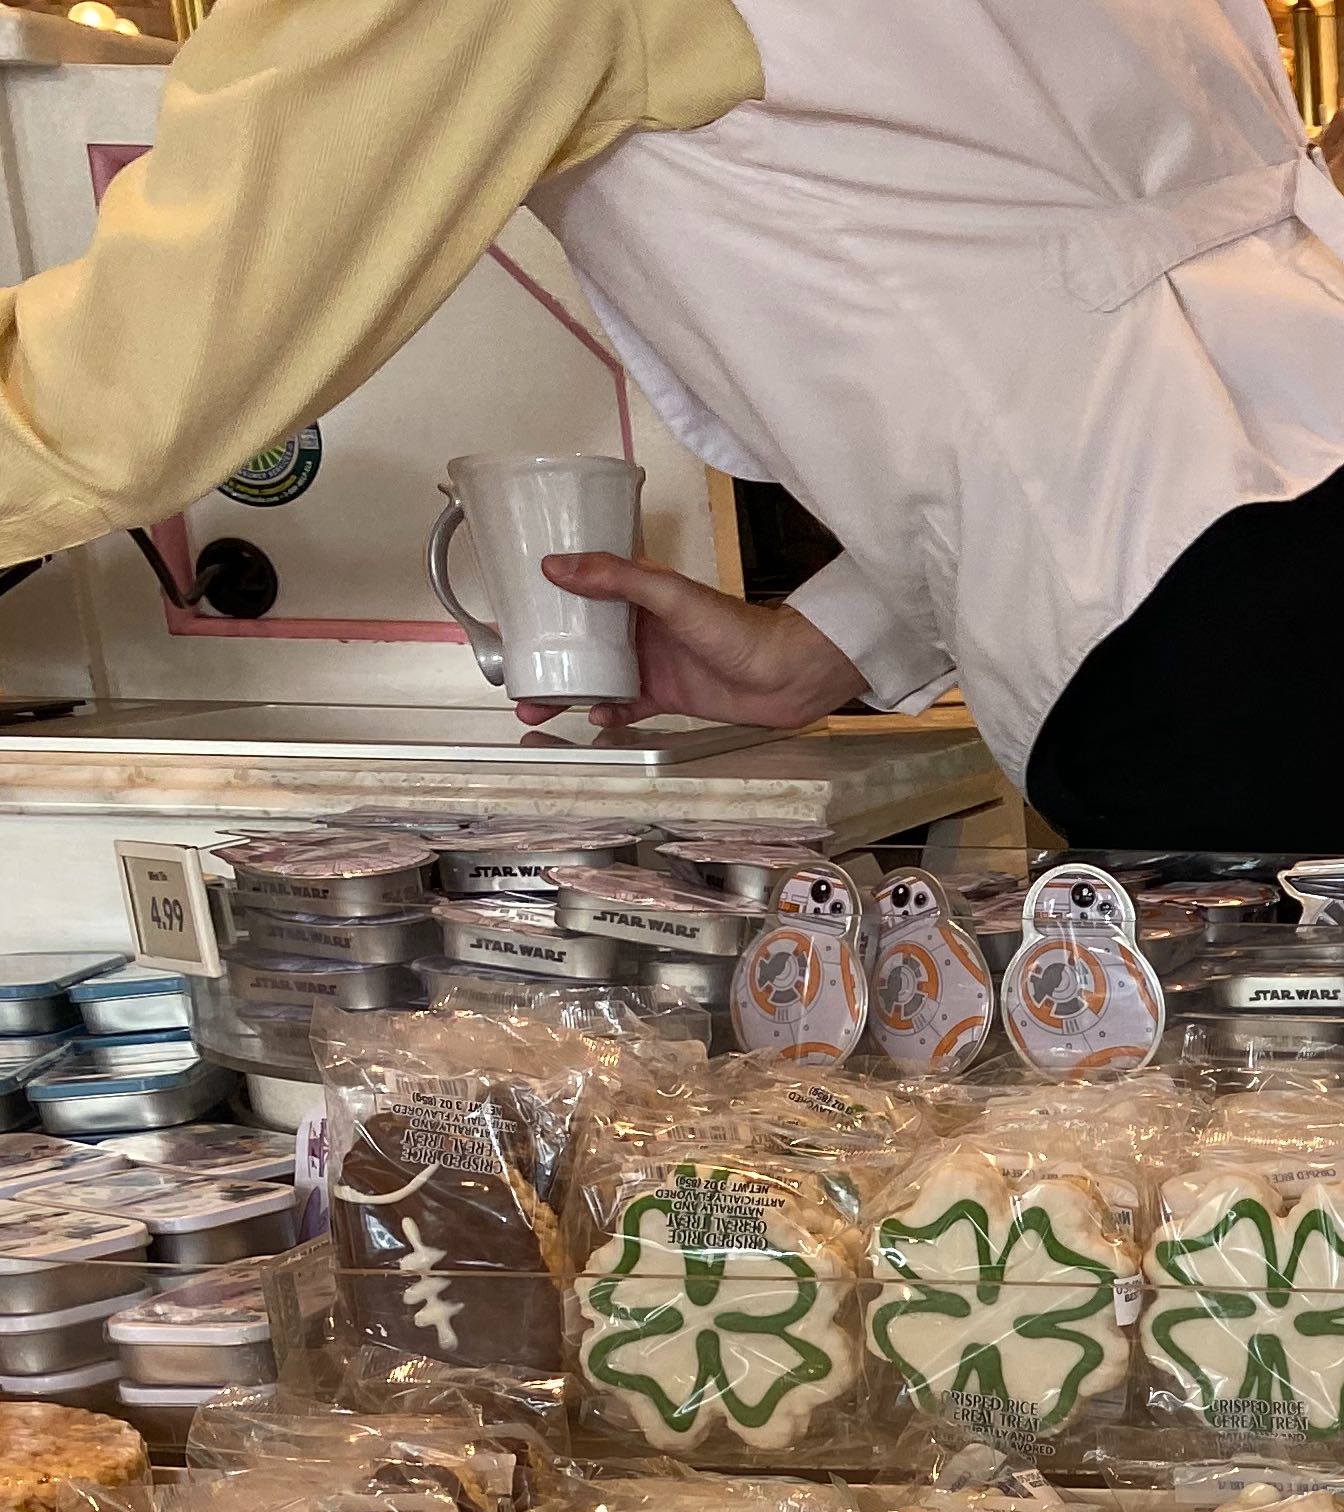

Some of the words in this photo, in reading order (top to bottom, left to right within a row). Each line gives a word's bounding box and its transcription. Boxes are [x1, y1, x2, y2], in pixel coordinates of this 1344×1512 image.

[470, 866, 517, 878] STAR
[151, 896, 183, 932] 4.99
[593, 911, 646, 928] STAR
[646, 919, 699, 938] WARS
[470, 938, 518, 954] STAR
[518, 944, 566, 962] WARS
[1249, 990, 1295, 1001] STAR
[1296, 990, 1341, 1000] WARS
[440, 1099, 452, 1109] OZ
[393, 1104, 449, 1121] FLAVORED
[412, 1119, 437, 1130] AND
[404, 1130, 445, 1149] TREAT
[401, 1149, 439, 1164] RICE
[442, 1155, 503, 1174] CRISPED
[704, 1179, 717, 1190] OZ
[749, 1182, 768, 1194] NET
[656, 1189, 714, 1202] FLAVORED
[714, 1192, 785, 1207] ARTIFICIALLY
[673, 1201, 699, 1212] AND
[700, 1202, 764, 1217] NATURALLY
[667, 1213, 709, 1229] TREAT
[713, 1217, 767, 1233] CEREAL
[668, 1229, 700, 1244] RICE
[706, 1232, 768, 1249] CRISPED
[1006, 1400, 1038, 1415] RICE
[1210, 1399, 1270, 1414] CRISPED
[1272, 1401, 1304, 1415] RICE
[1000, 1414, 1042, 1432] TREAT
[1213, 1415, 1267, 1429] CEREAL
[1270, 1416, 1310, 1430] TREAT
[1011, 1432, 1035, 1443] AND
